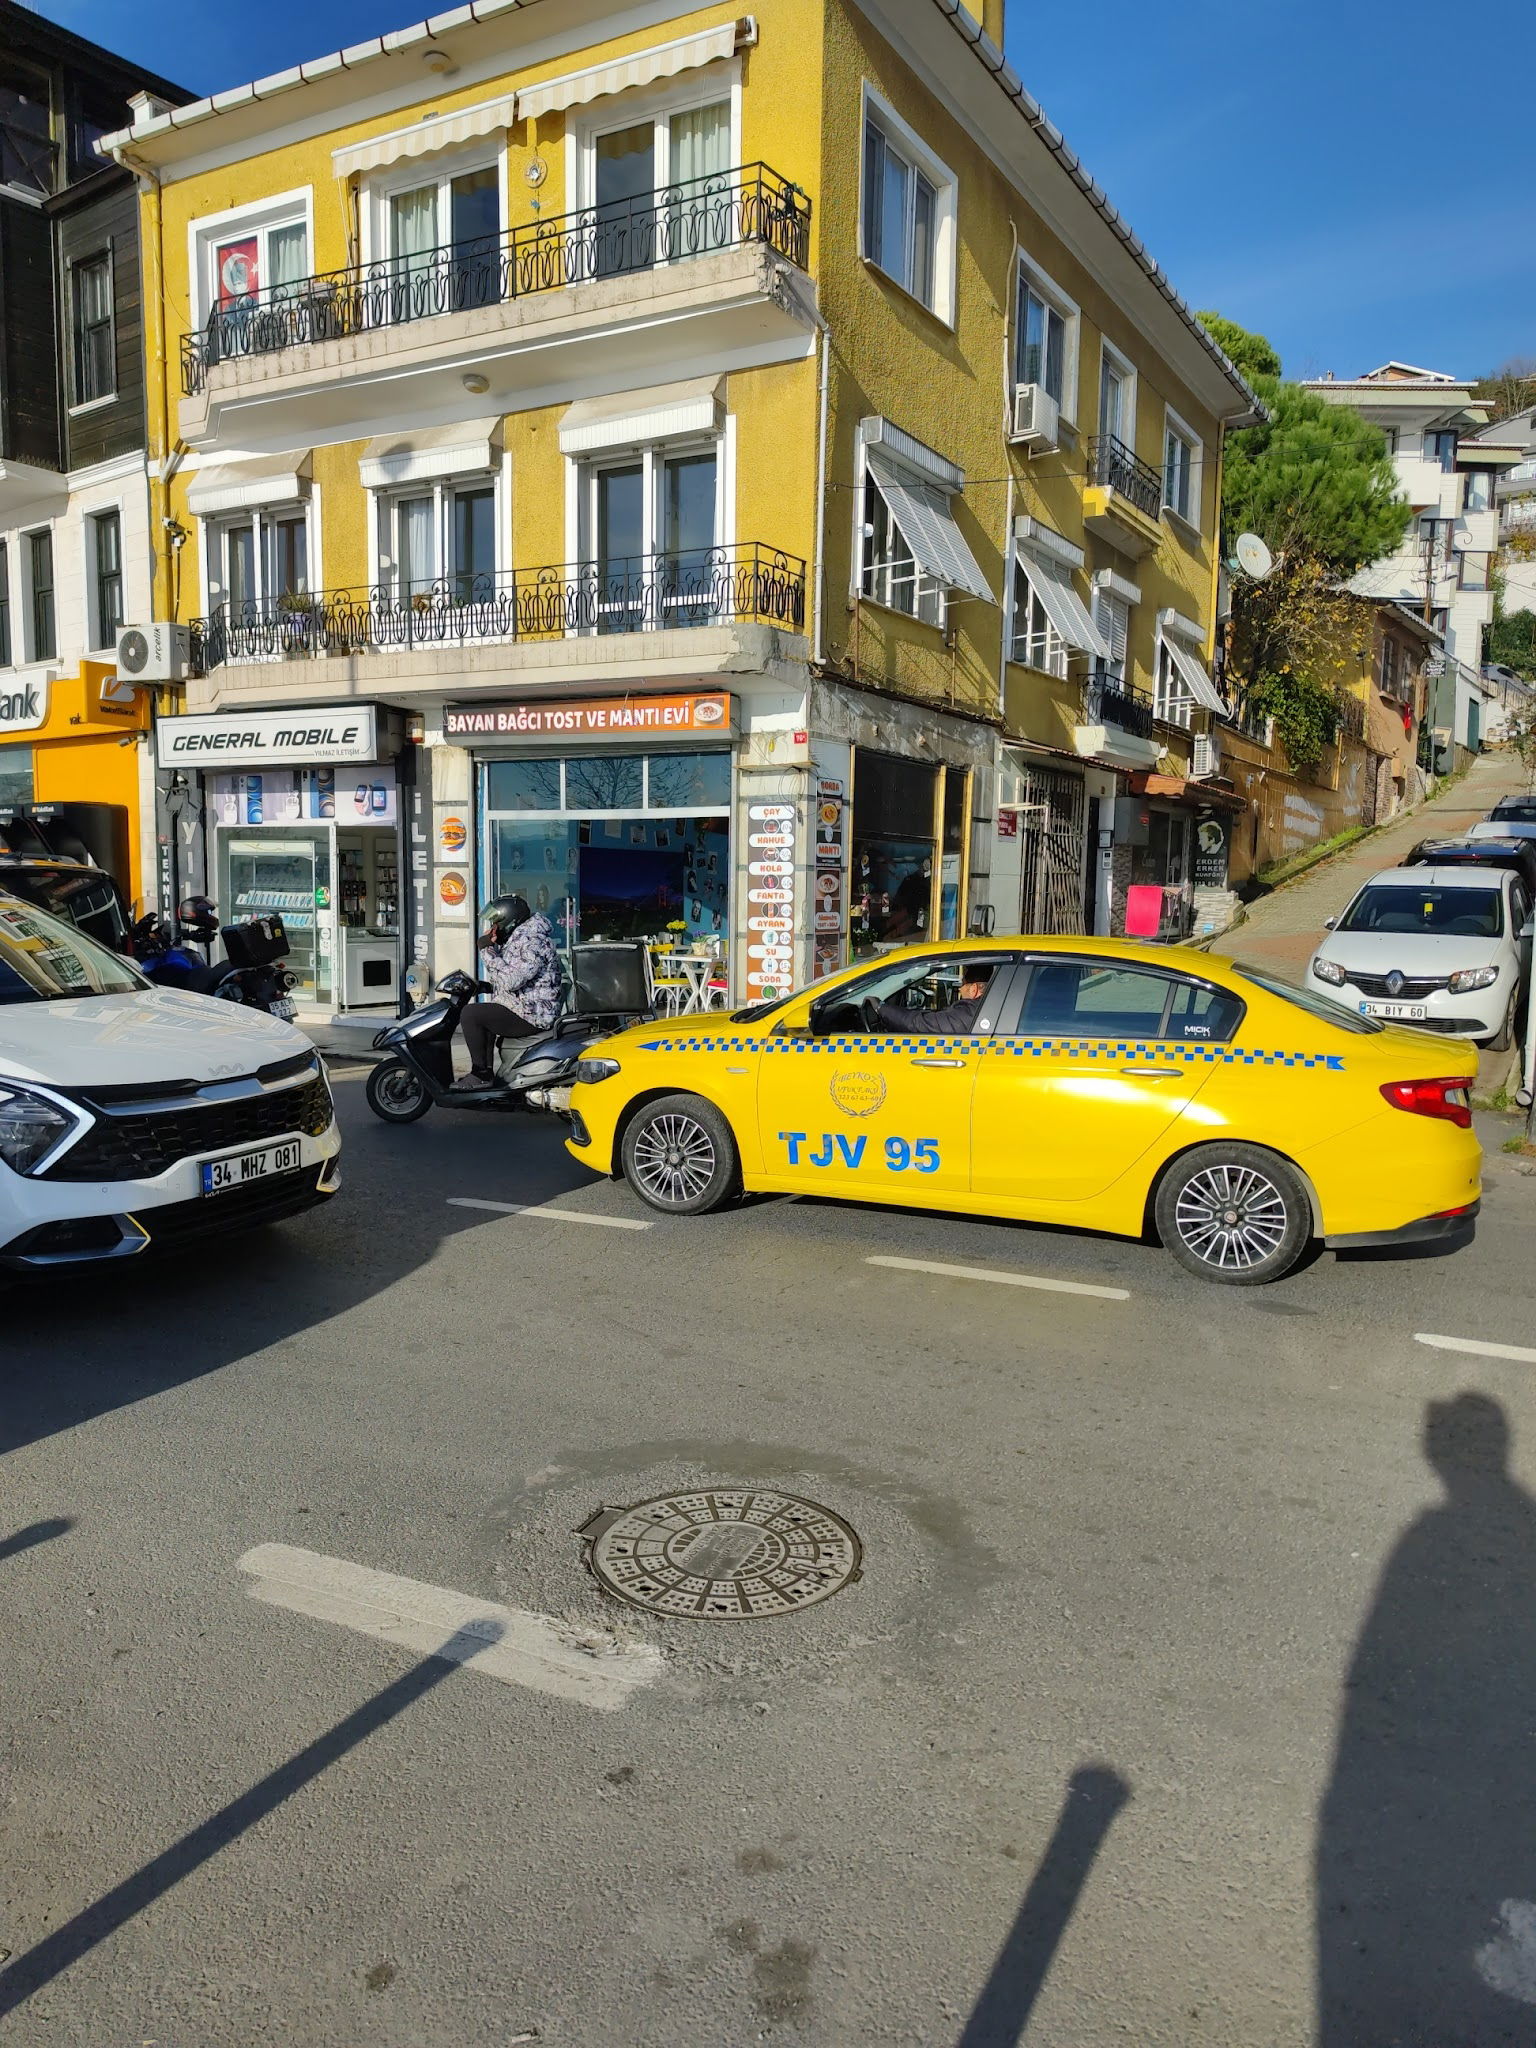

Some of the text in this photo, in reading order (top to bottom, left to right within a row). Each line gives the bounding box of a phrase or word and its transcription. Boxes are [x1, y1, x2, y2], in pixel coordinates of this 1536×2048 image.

[0, 683, 40, 721] ank
[447, 701, 689, 732] BAYAN BAĞCI TOST VE MANTI EVİ
[172, 727, 359, 751] GENERAL MOBILE
[314, 749, 335, 757] YILMAZ
[763, 808, 780, 817] ÇAY
[161, 846, 172, 921] TEKNİK
[411, 792, 429, 965] İLETİŞ
[757, 920, 786, 928] AYRAN
[759, 975, 781, 983] SODA
[1366, 1004, 1422, 1017] 34 BIY 60
[213, 1145, 297, 1186] 34 MHZ 081
[778, 1131, 941, 1173] TJV 95
